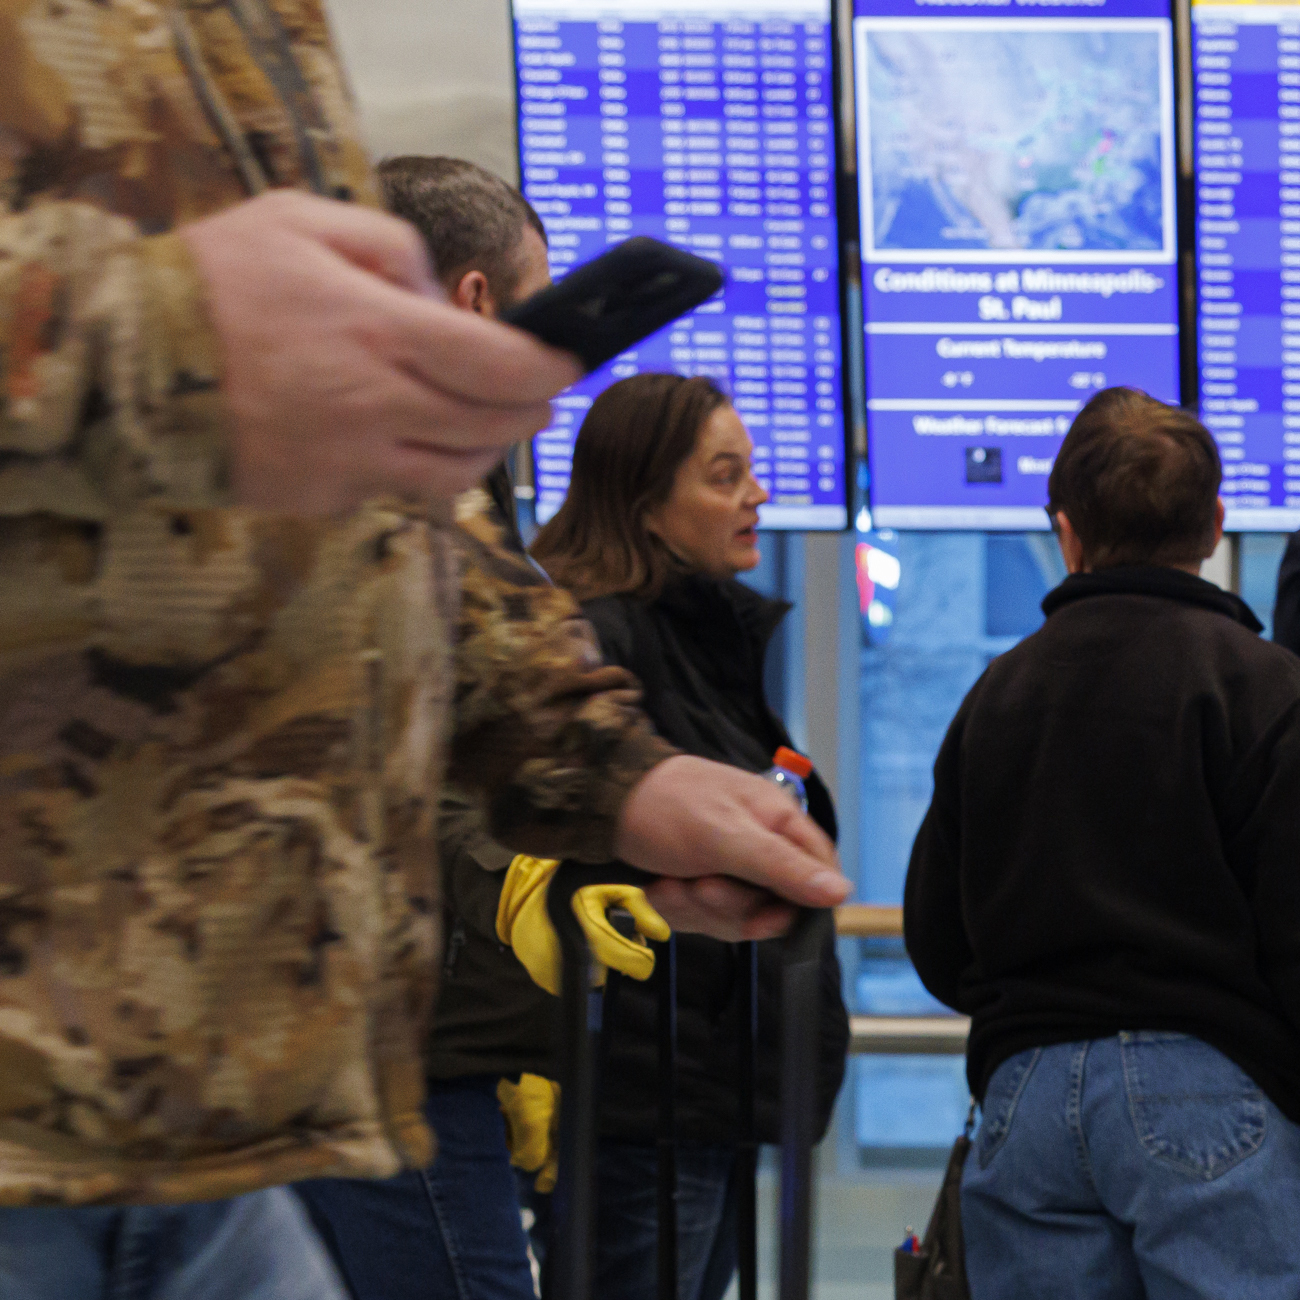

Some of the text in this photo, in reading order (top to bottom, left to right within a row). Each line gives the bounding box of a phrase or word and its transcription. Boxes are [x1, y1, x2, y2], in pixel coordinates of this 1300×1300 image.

[874, 267, 992, 293] Conditions
[995, 270, 1019, 293] at
[1012, 296, 1061, 320] Paul
[937, 338, 1107, 362] Current Temperature
[913, 415, 982, 435] Weather
[985, 415, 1053, 436] Forecast
